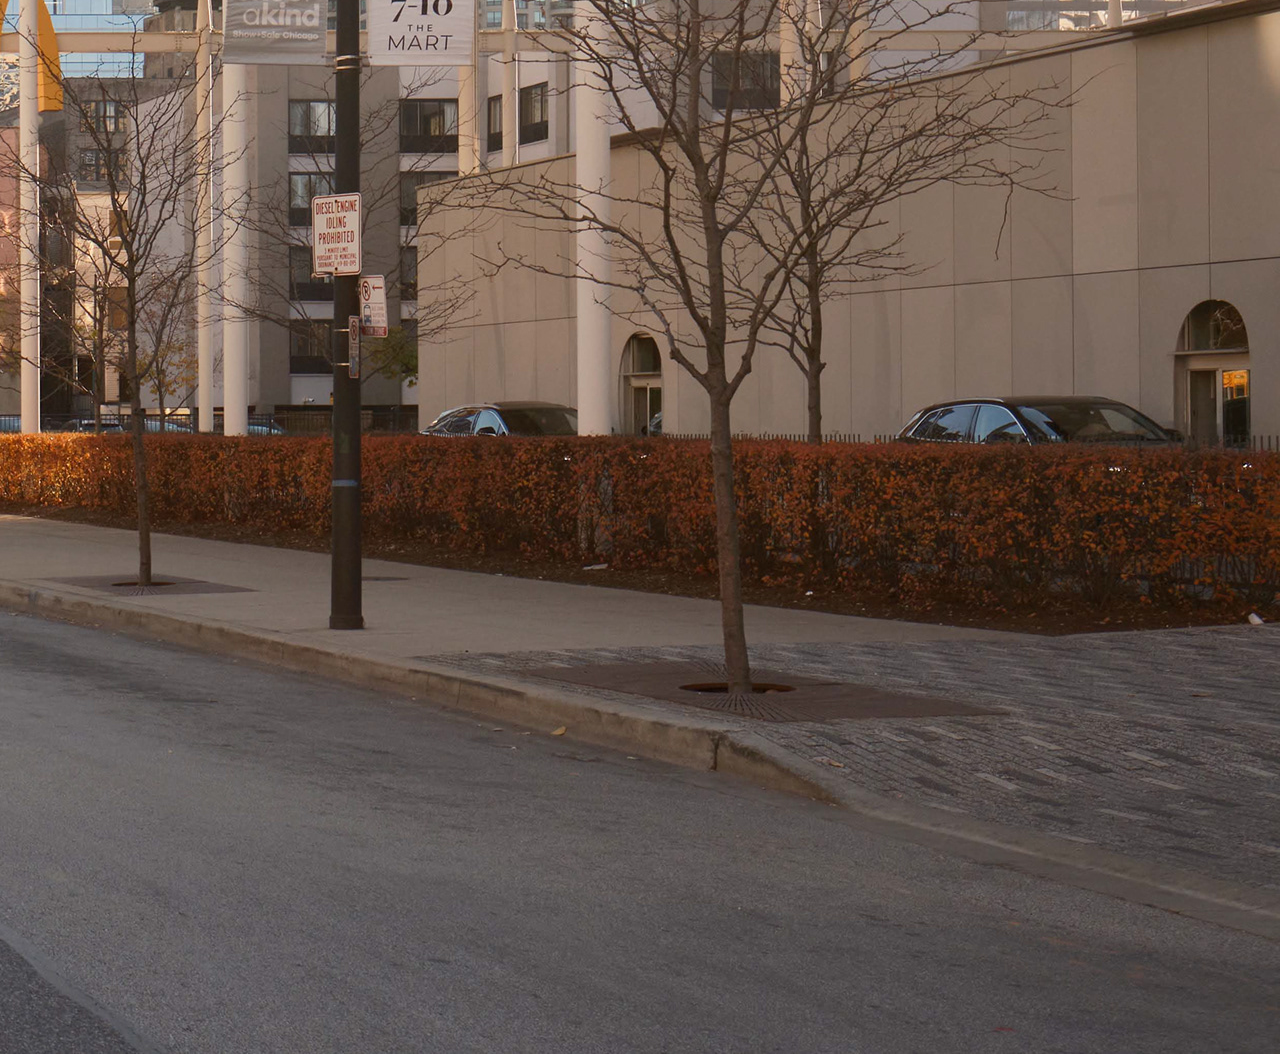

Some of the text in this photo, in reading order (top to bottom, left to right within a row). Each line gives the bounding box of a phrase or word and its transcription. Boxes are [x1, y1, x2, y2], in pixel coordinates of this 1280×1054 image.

[408, 24, 433, 32] THE
[282, 31, 319, 40] Chicago
[388, 35, 453, 50] MART
[316, 200, 357, 215] DIESEL ENGINE
[326, 216, 346, 229] IDLING
[319, 230, 354, 244] PROHIBITED
